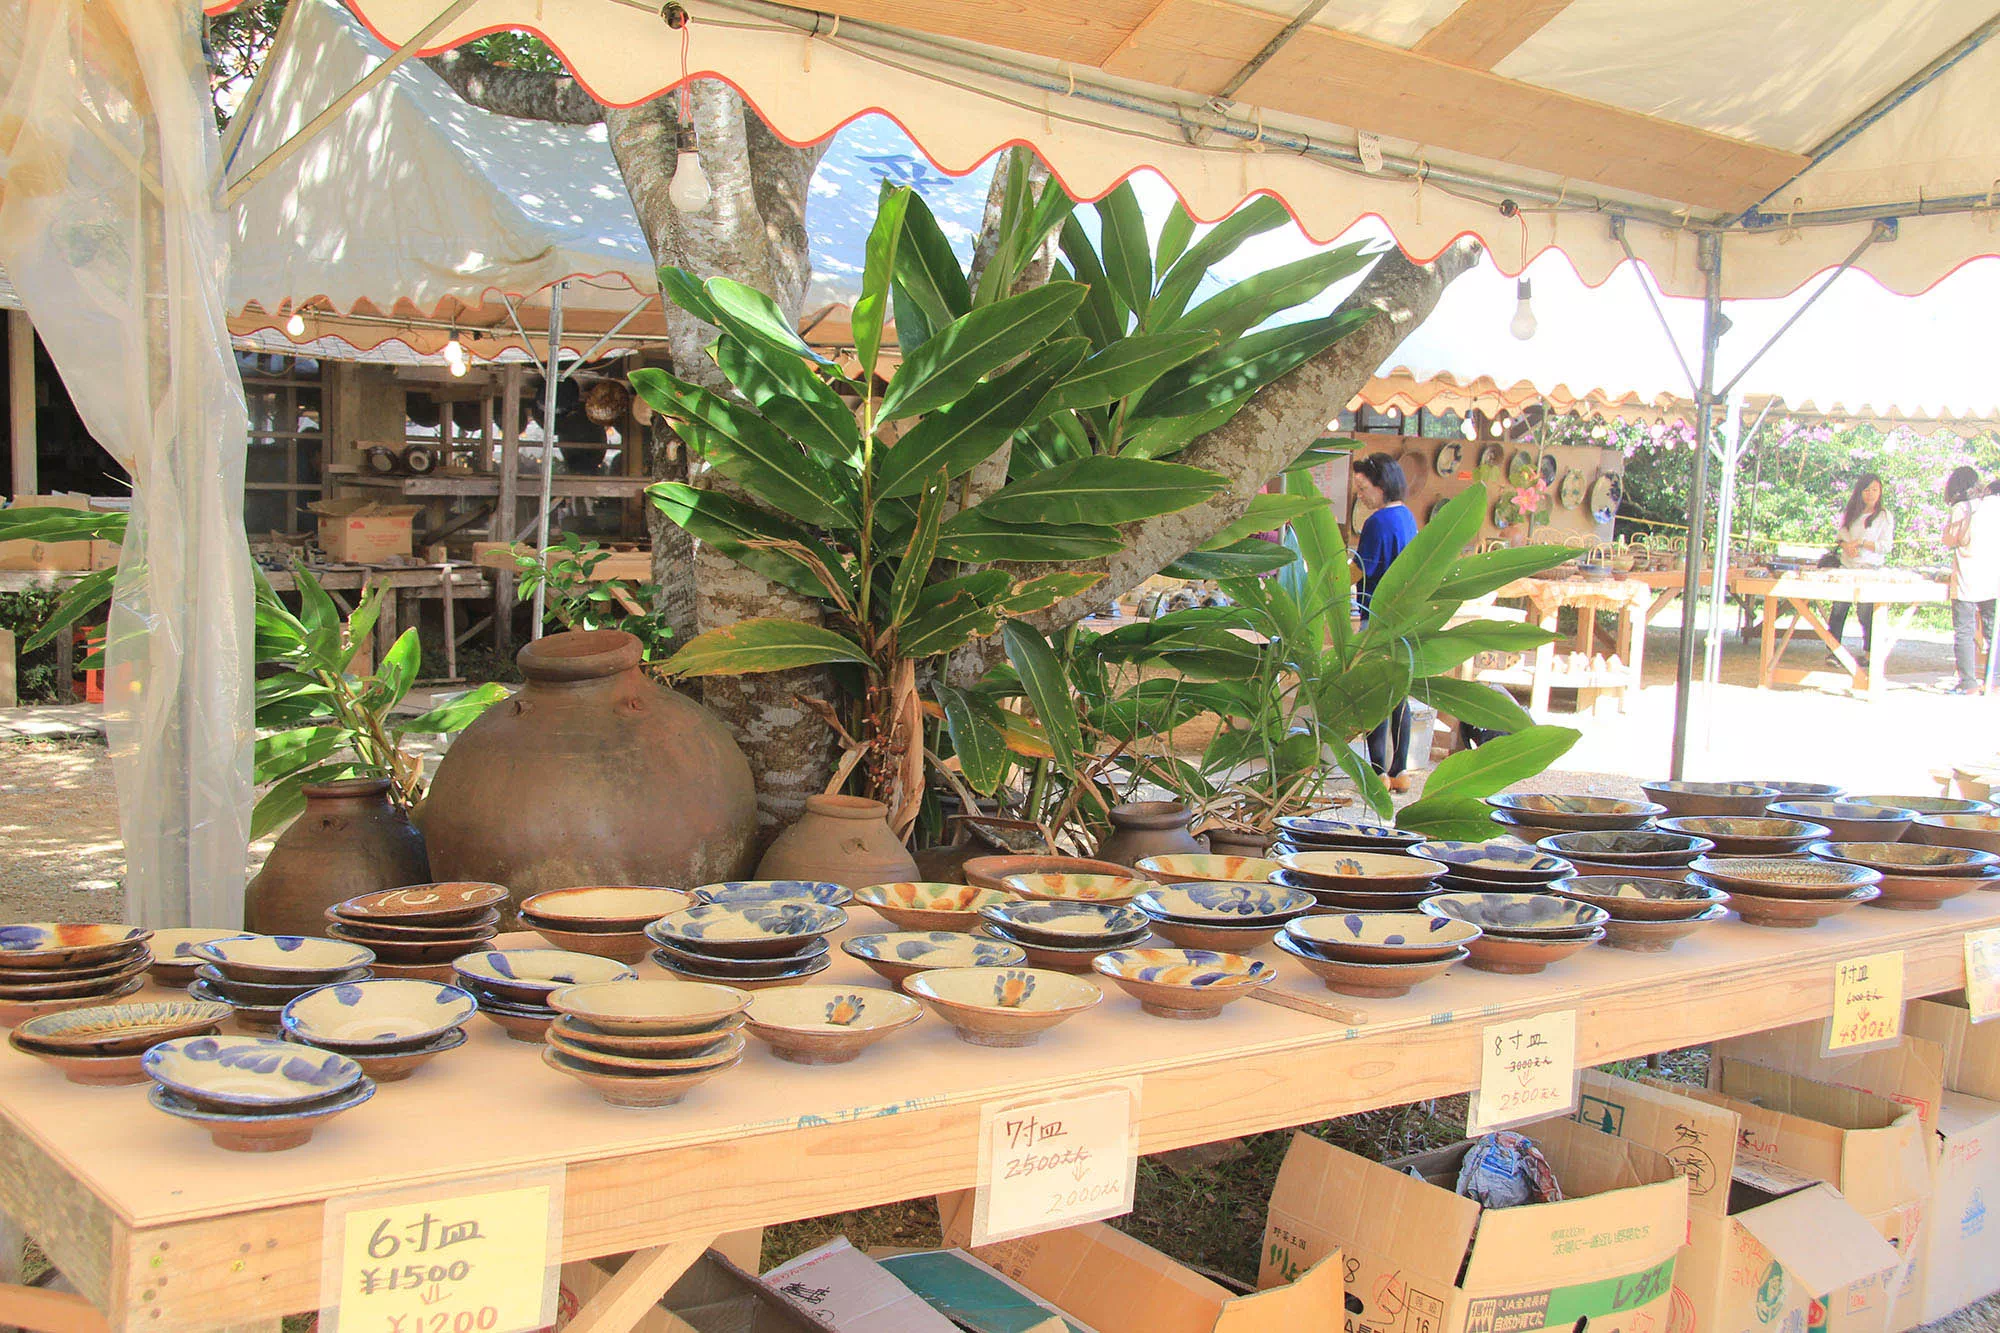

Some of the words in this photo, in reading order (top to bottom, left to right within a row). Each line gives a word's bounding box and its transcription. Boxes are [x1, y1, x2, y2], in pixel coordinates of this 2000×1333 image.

[1493, 1029, 1548, 1057] 8寸皿
[1497, 1087, 1560, 1110] 2500えん
[1006, 1116, 1068, 1149] 7寸皿
[1004, 1146, 1092, 1179] 2500えん
[1046, 1179, 1120, 1214] 2000えん
[367, 1213, 486, 1259] 6寸皿
[360, 1260, 471, 1295] ¥1500
[1612, 1266, 1663, 1309] レタス
